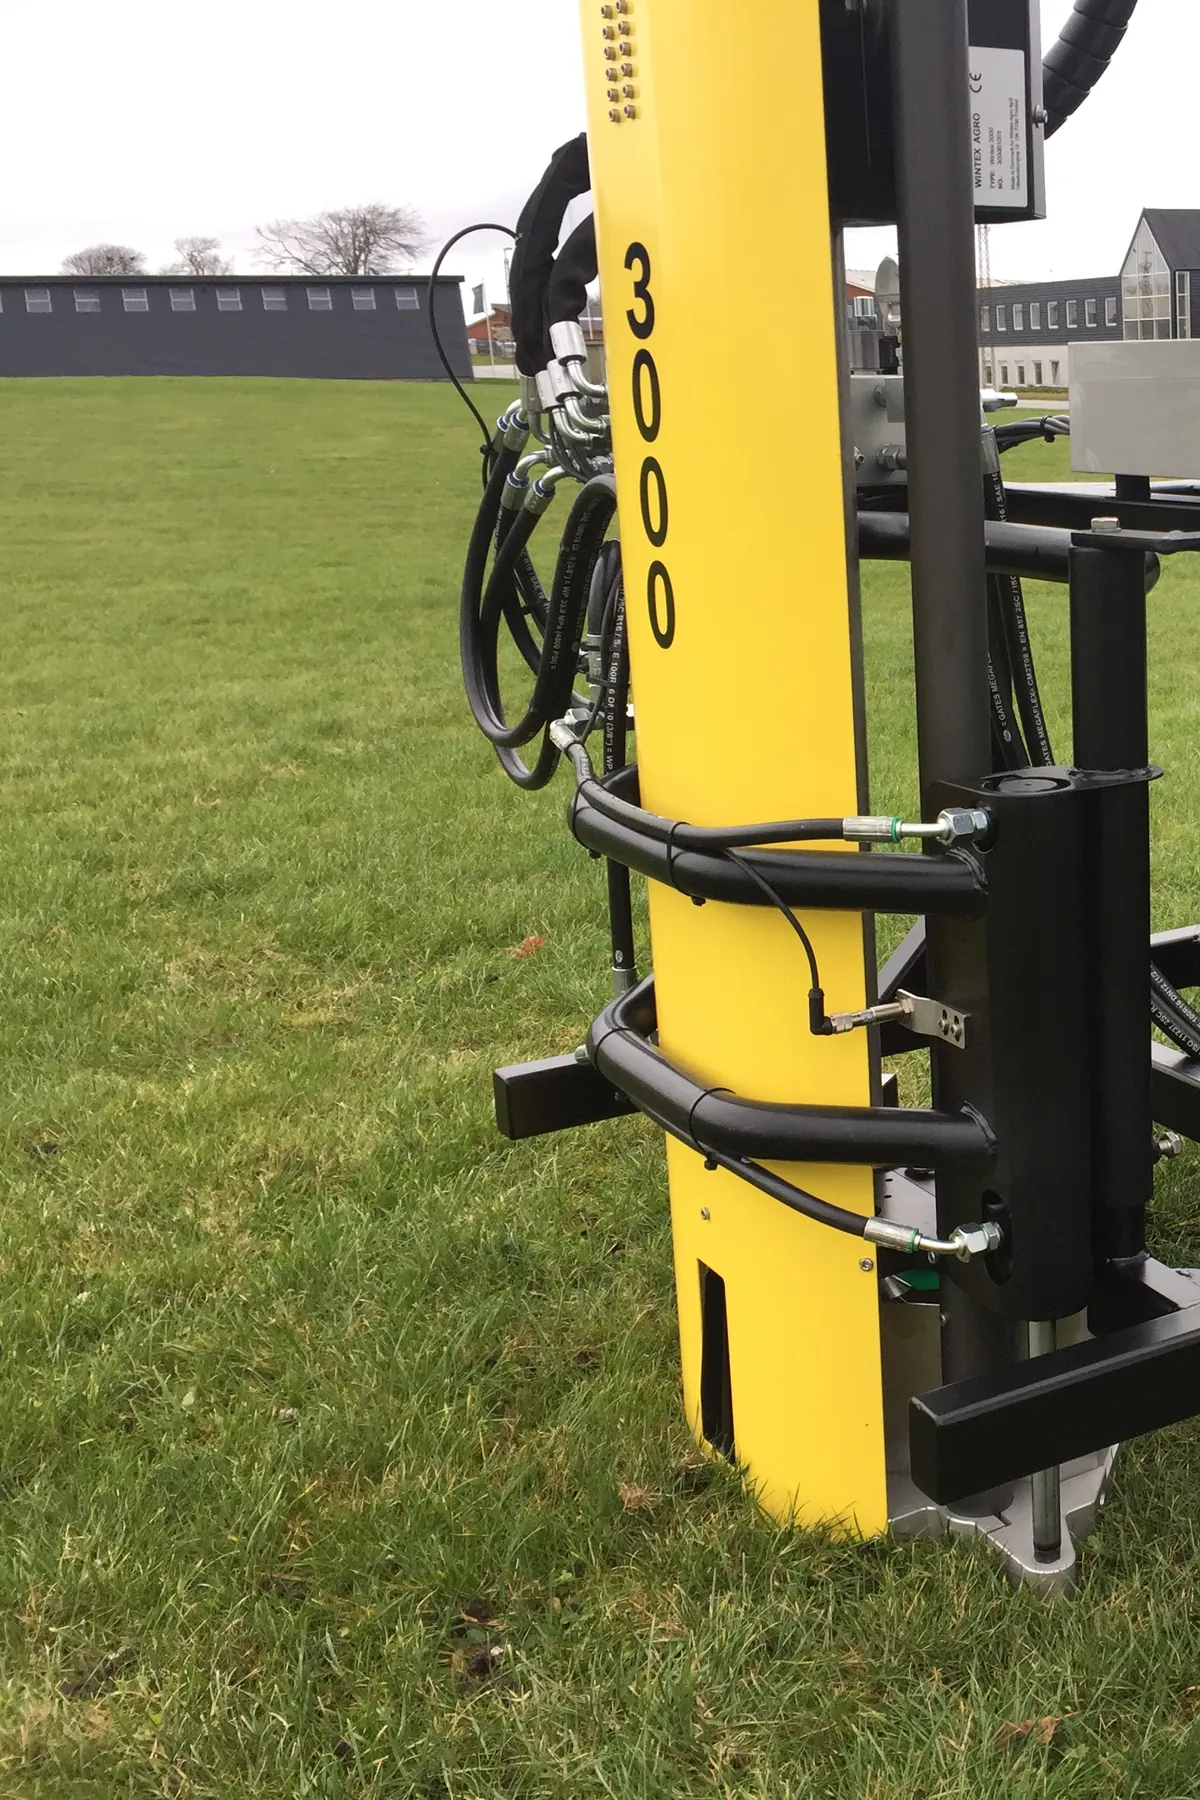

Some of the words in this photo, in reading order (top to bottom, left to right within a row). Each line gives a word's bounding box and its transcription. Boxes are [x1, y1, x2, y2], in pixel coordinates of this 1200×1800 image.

[624, 241, 676, 650] 3000
[562, 586, 570, 598] WP
[608, 662, 618, 694] 100R6
[993, 694, 1006, 720] GATES
[606, 756, 614, 770] WP
[1160, 983, 1178, 1002] DN12
[1156, 1012, 1170, 1026] 2SC
[1176, 1000, 1198, 1022] 100R16
[1168, 1024, 1186, 1040] 11237
[1186, 1040, 1200, 1052] ISO
